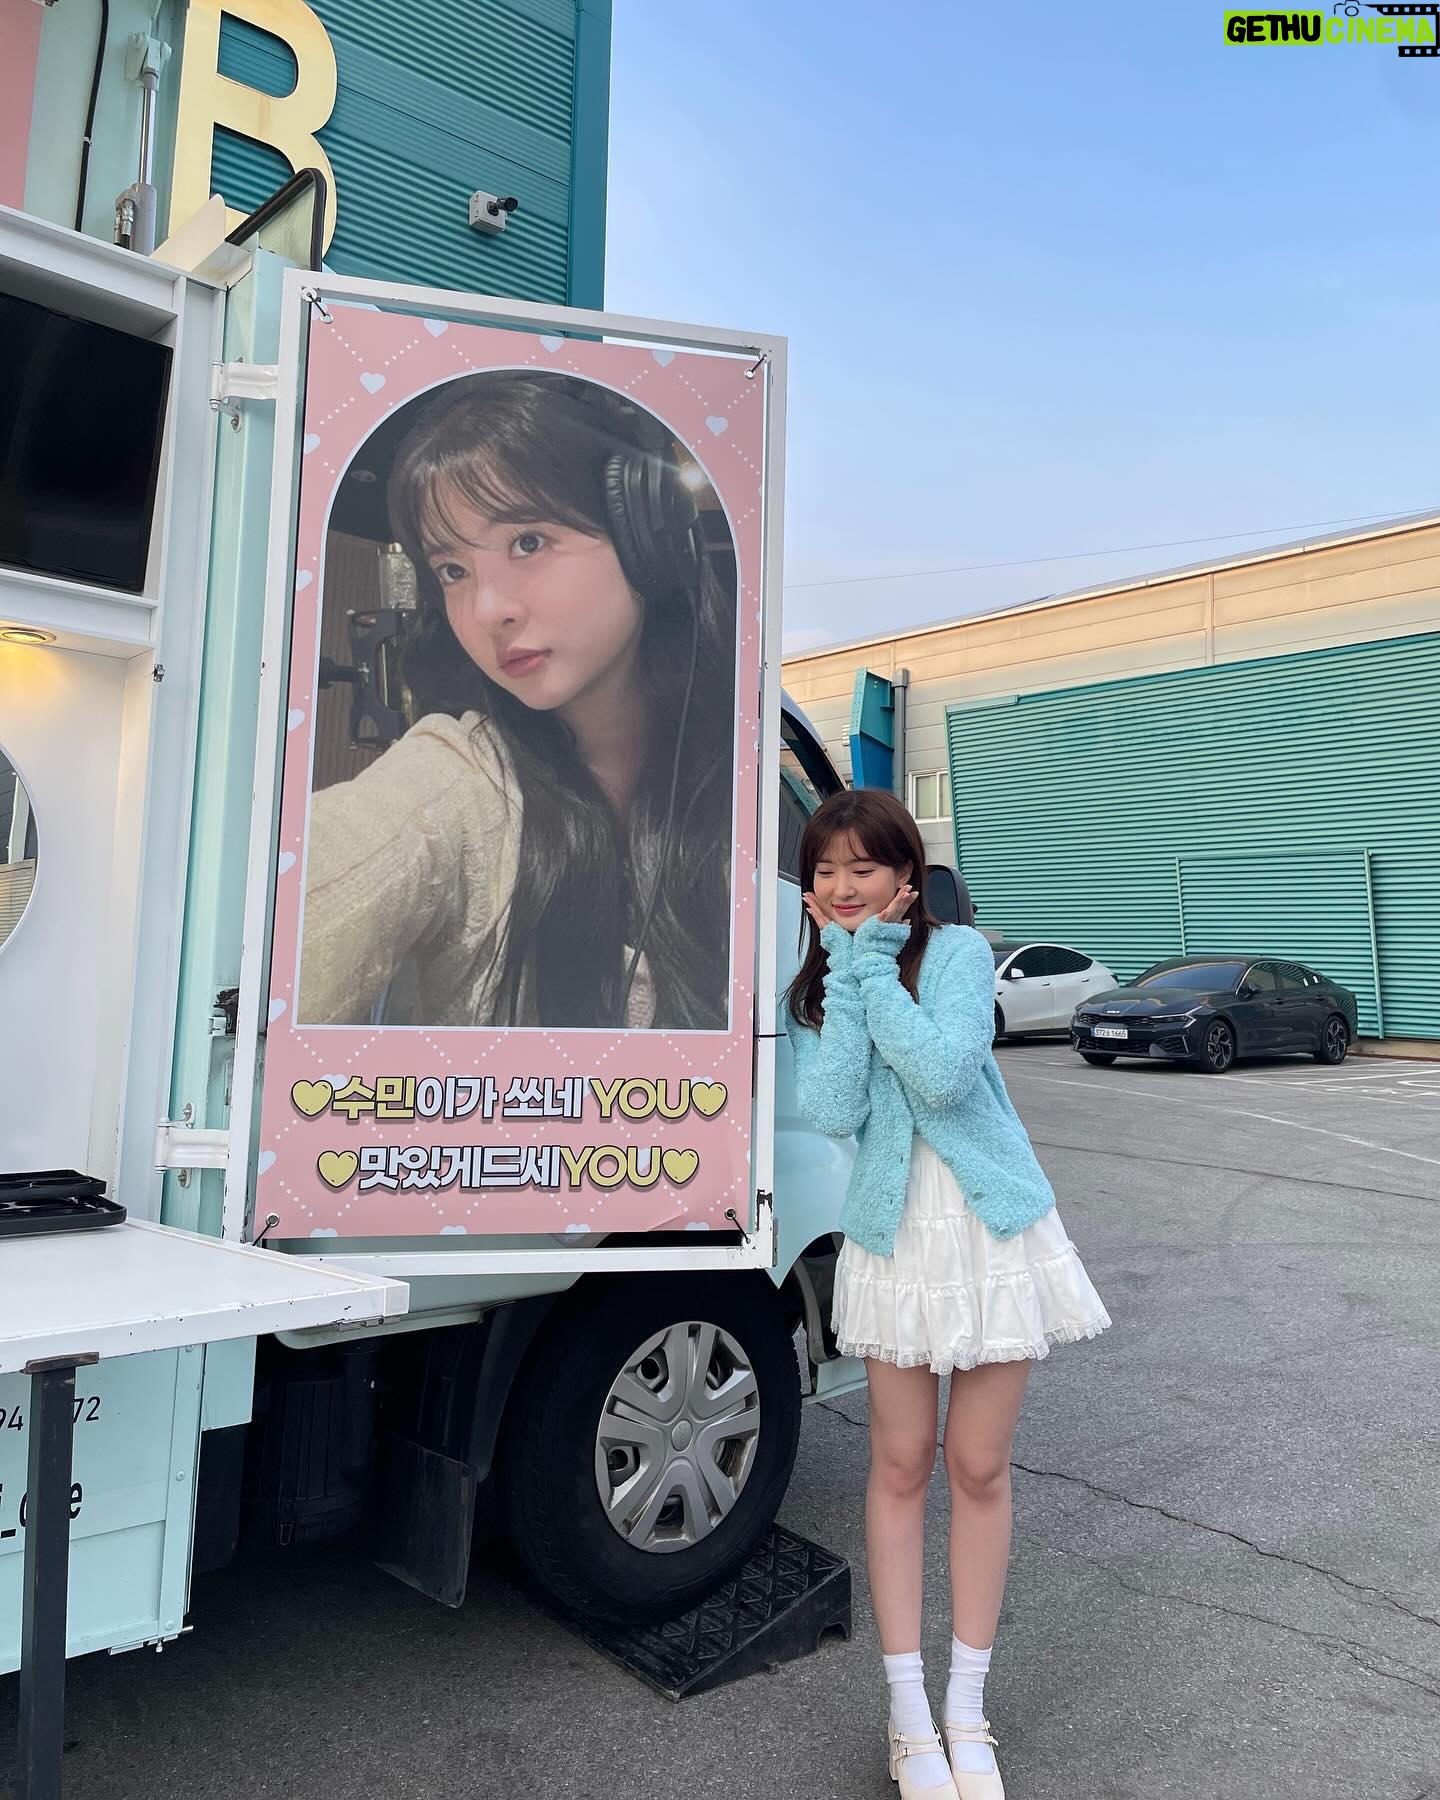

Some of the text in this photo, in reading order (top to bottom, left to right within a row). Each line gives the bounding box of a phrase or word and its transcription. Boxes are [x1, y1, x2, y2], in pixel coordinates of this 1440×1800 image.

[331, 1075, 691, 1120] 수민이가 쏘네 YOU
